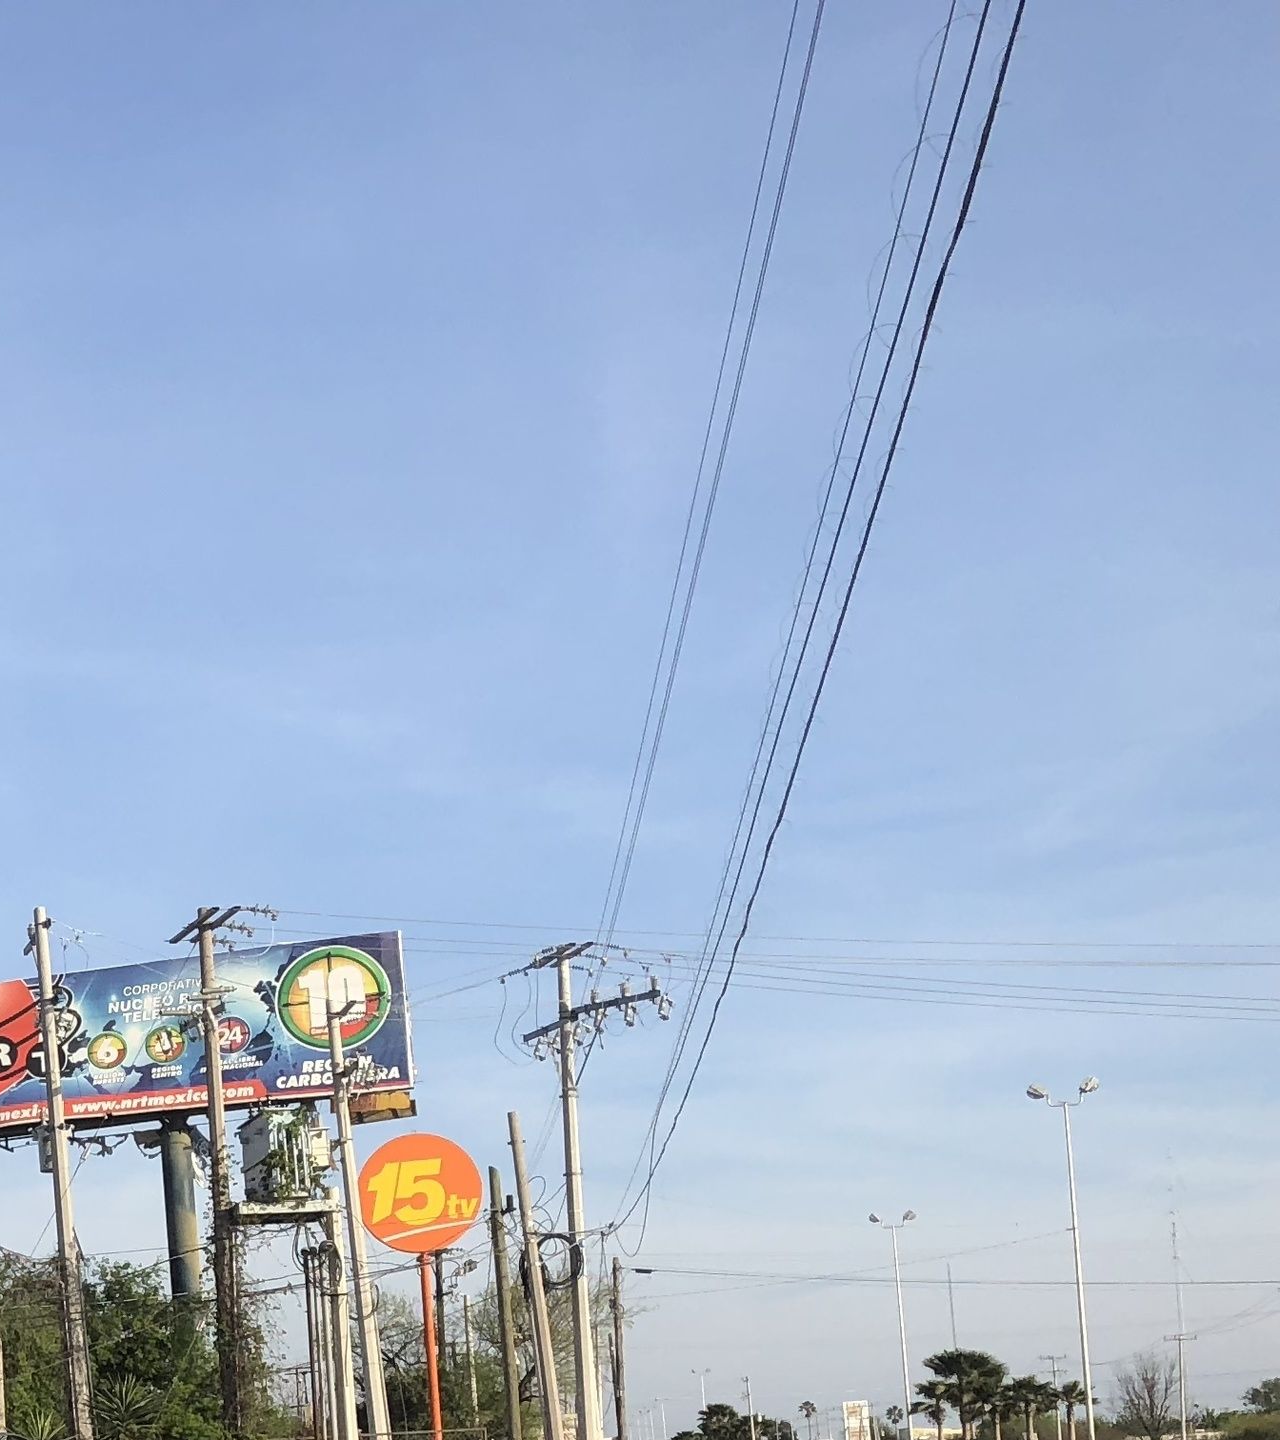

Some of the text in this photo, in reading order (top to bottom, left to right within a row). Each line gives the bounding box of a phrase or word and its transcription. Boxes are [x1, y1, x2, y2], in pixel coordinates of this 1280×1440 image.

[123, 979, 202, 997] CORPORATIV
[72, 1086, 254, 1114] www.nrtmexicoom
[367, 1158, 479, 1226] 15 tv
